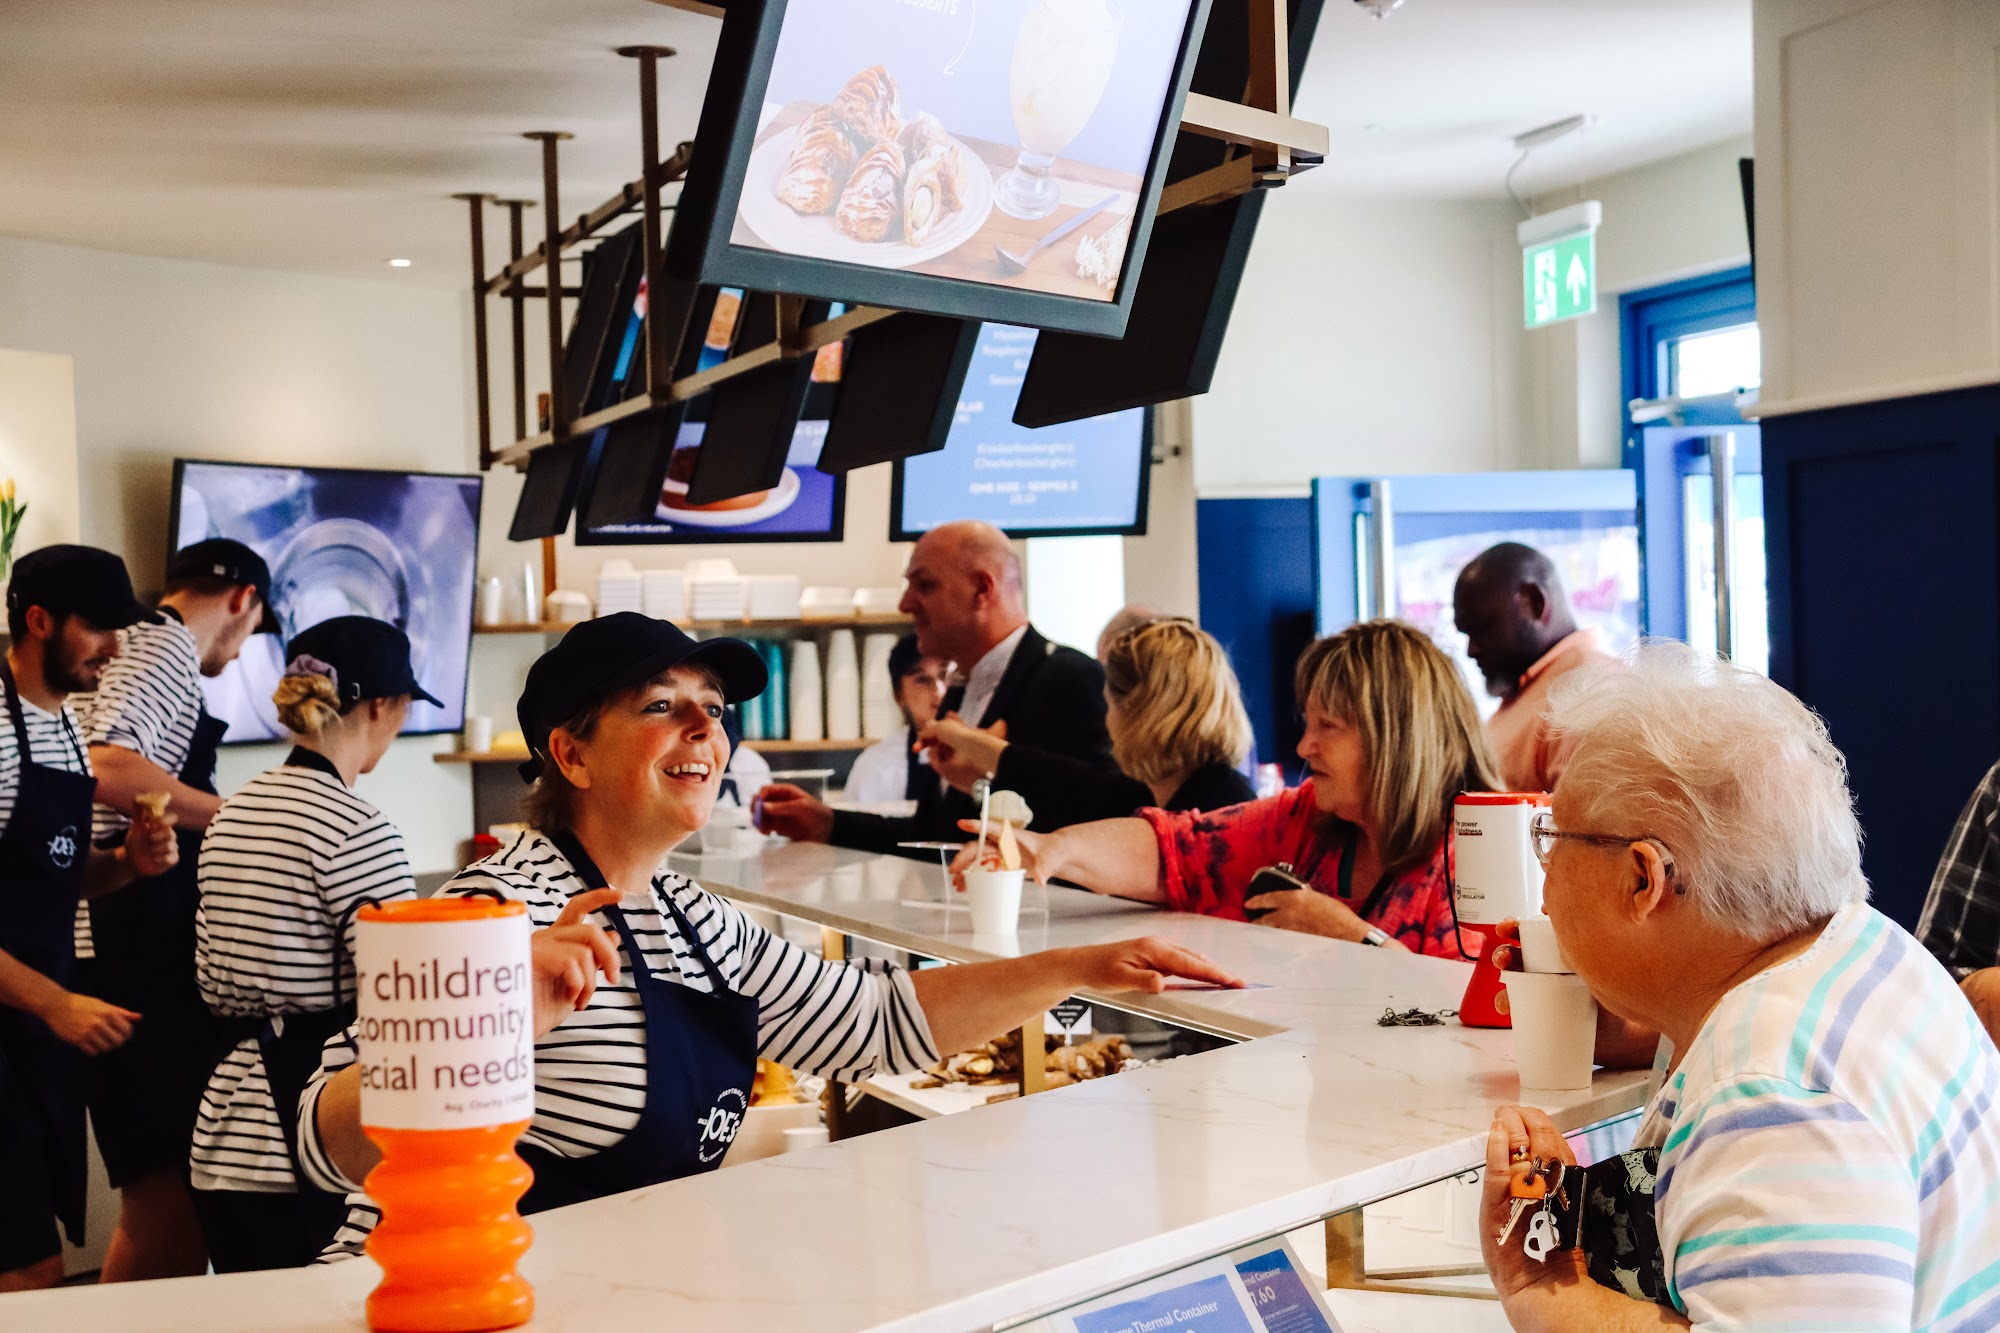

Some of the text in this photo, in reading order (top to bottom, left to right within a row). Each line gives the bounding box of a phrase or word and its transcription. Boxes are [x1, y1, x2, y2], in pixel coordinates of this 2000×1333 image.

[374, 956, 526, 1001] children
[434, 1044, 528, 1089] needs
[1255, 1267, 1281, 1281] Container
[1131, 1311, 1174, 1333] Thermal
[1173, 1301, 1218, 1322] Container
